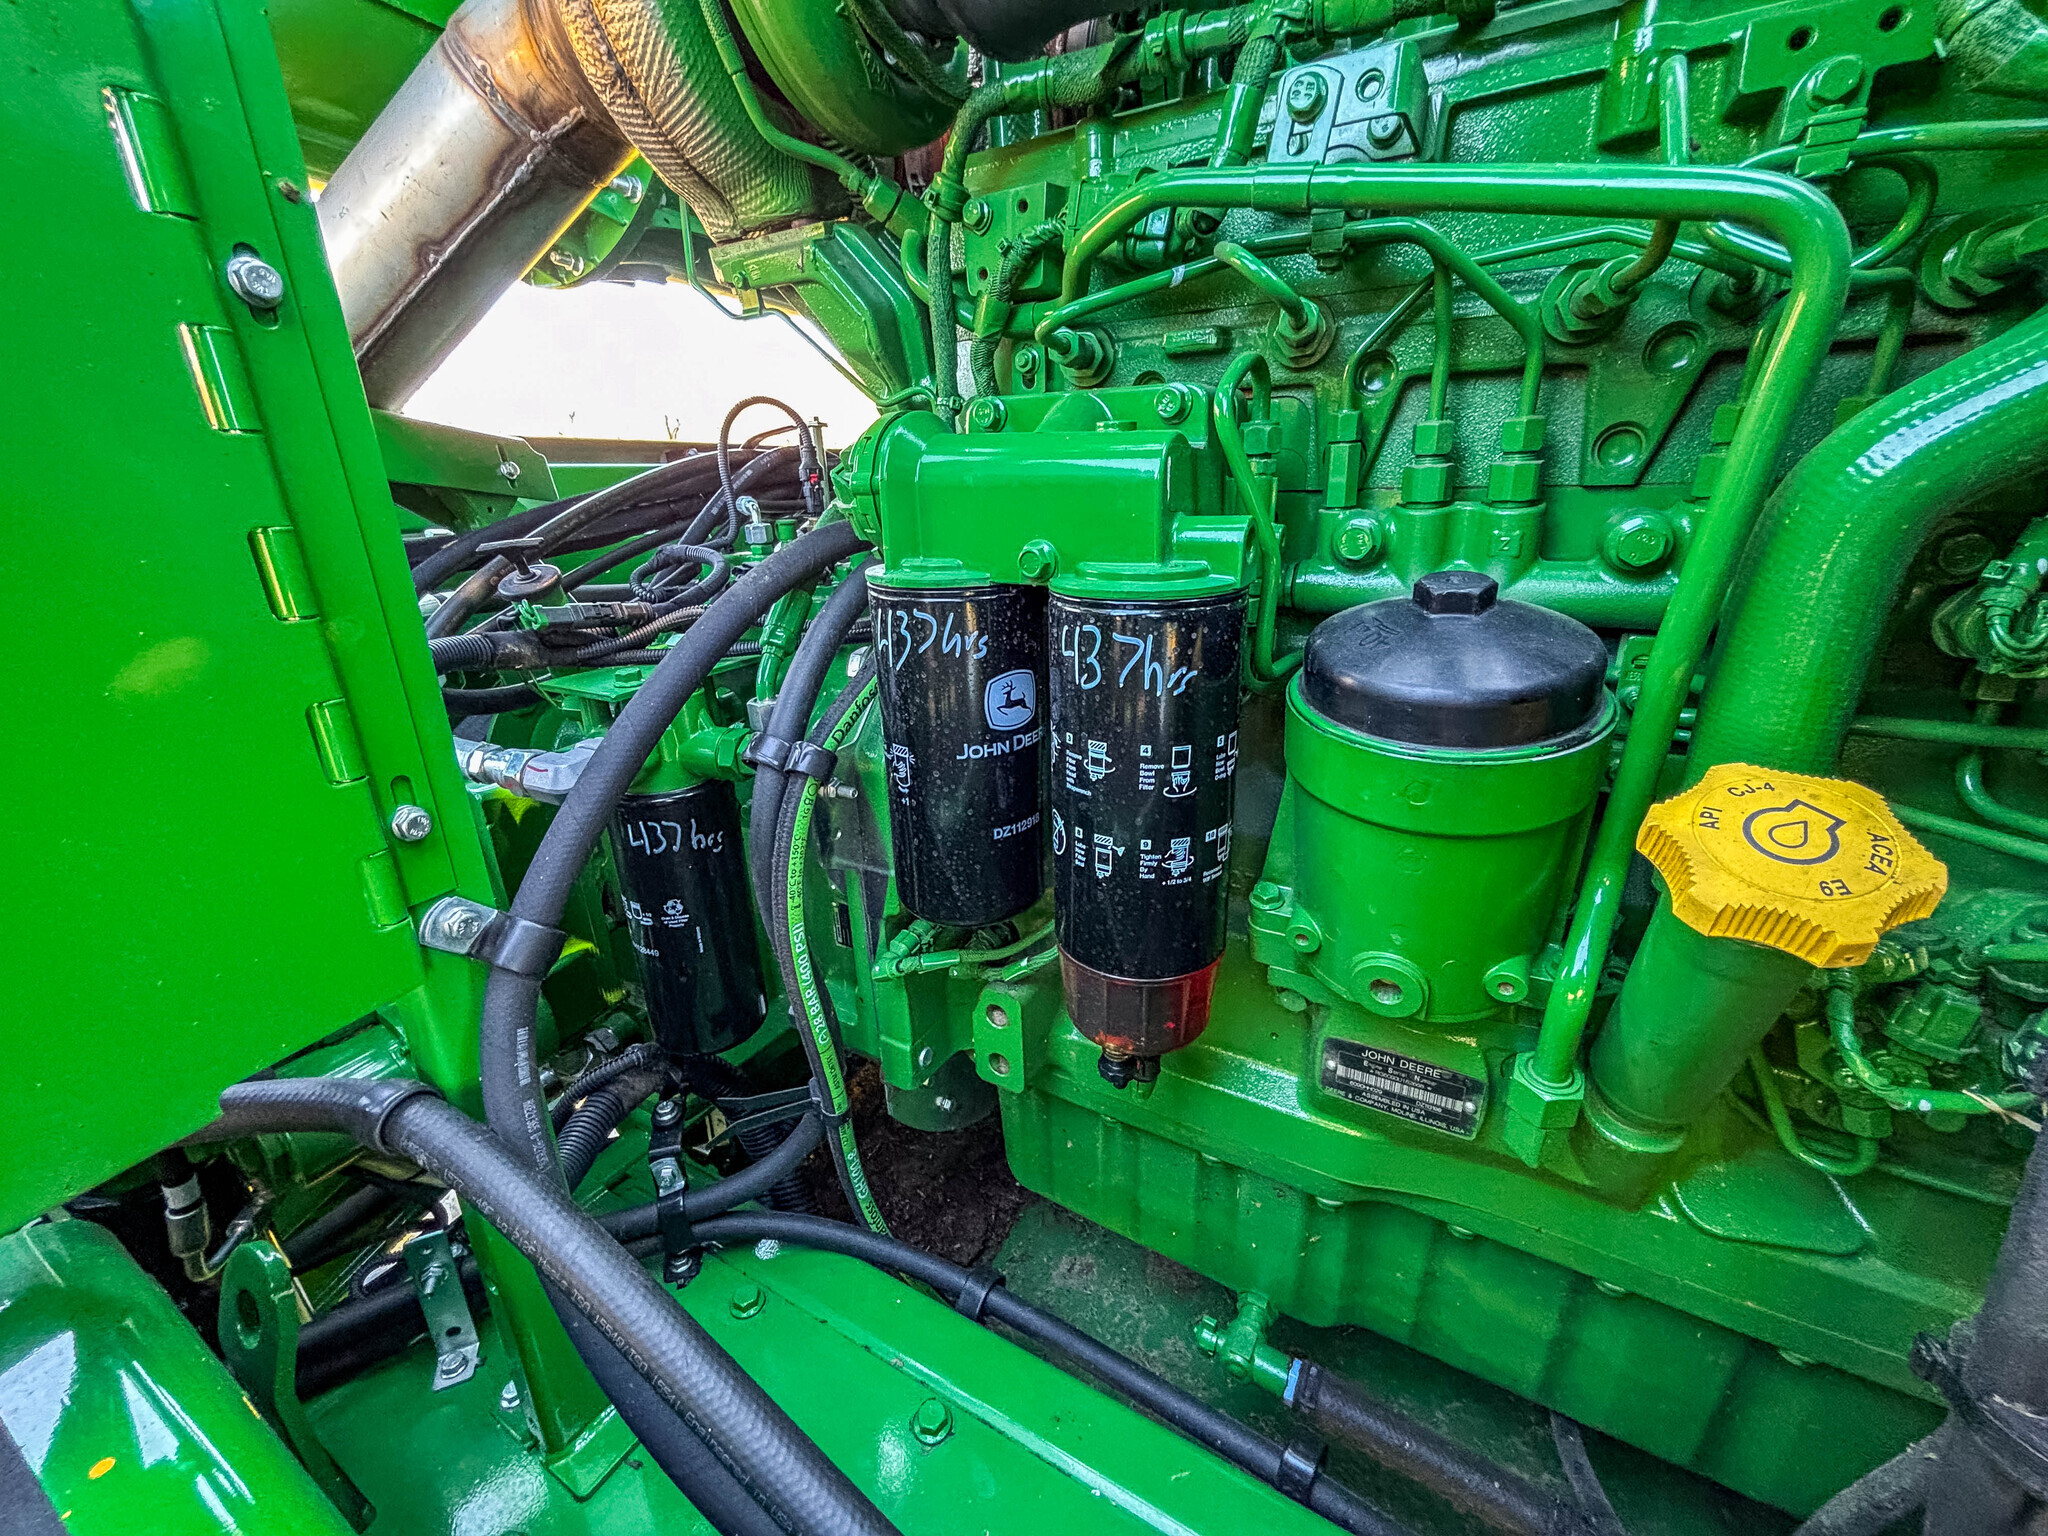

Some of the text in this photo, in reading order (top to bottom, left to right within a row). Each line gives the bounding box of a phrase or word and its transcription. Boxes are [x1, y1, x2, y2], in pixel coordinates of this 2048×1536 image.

[956, 740, 1010, 760] JOHN
[1727, 782, 1776, 798] CJ-4
[1699, 806, 1722, 830] API
[627, 820, 682, 856] 437
[1864, 831, 1893, 876] ACEA
[804, 986, 821, 1015] BAR
[1361, 1048, 1442, 1079] JOHN DEERE
[1361, 1091, 1400, 1108] ASSEMBLED
[1411, 1107, 1425, 1115] USA
